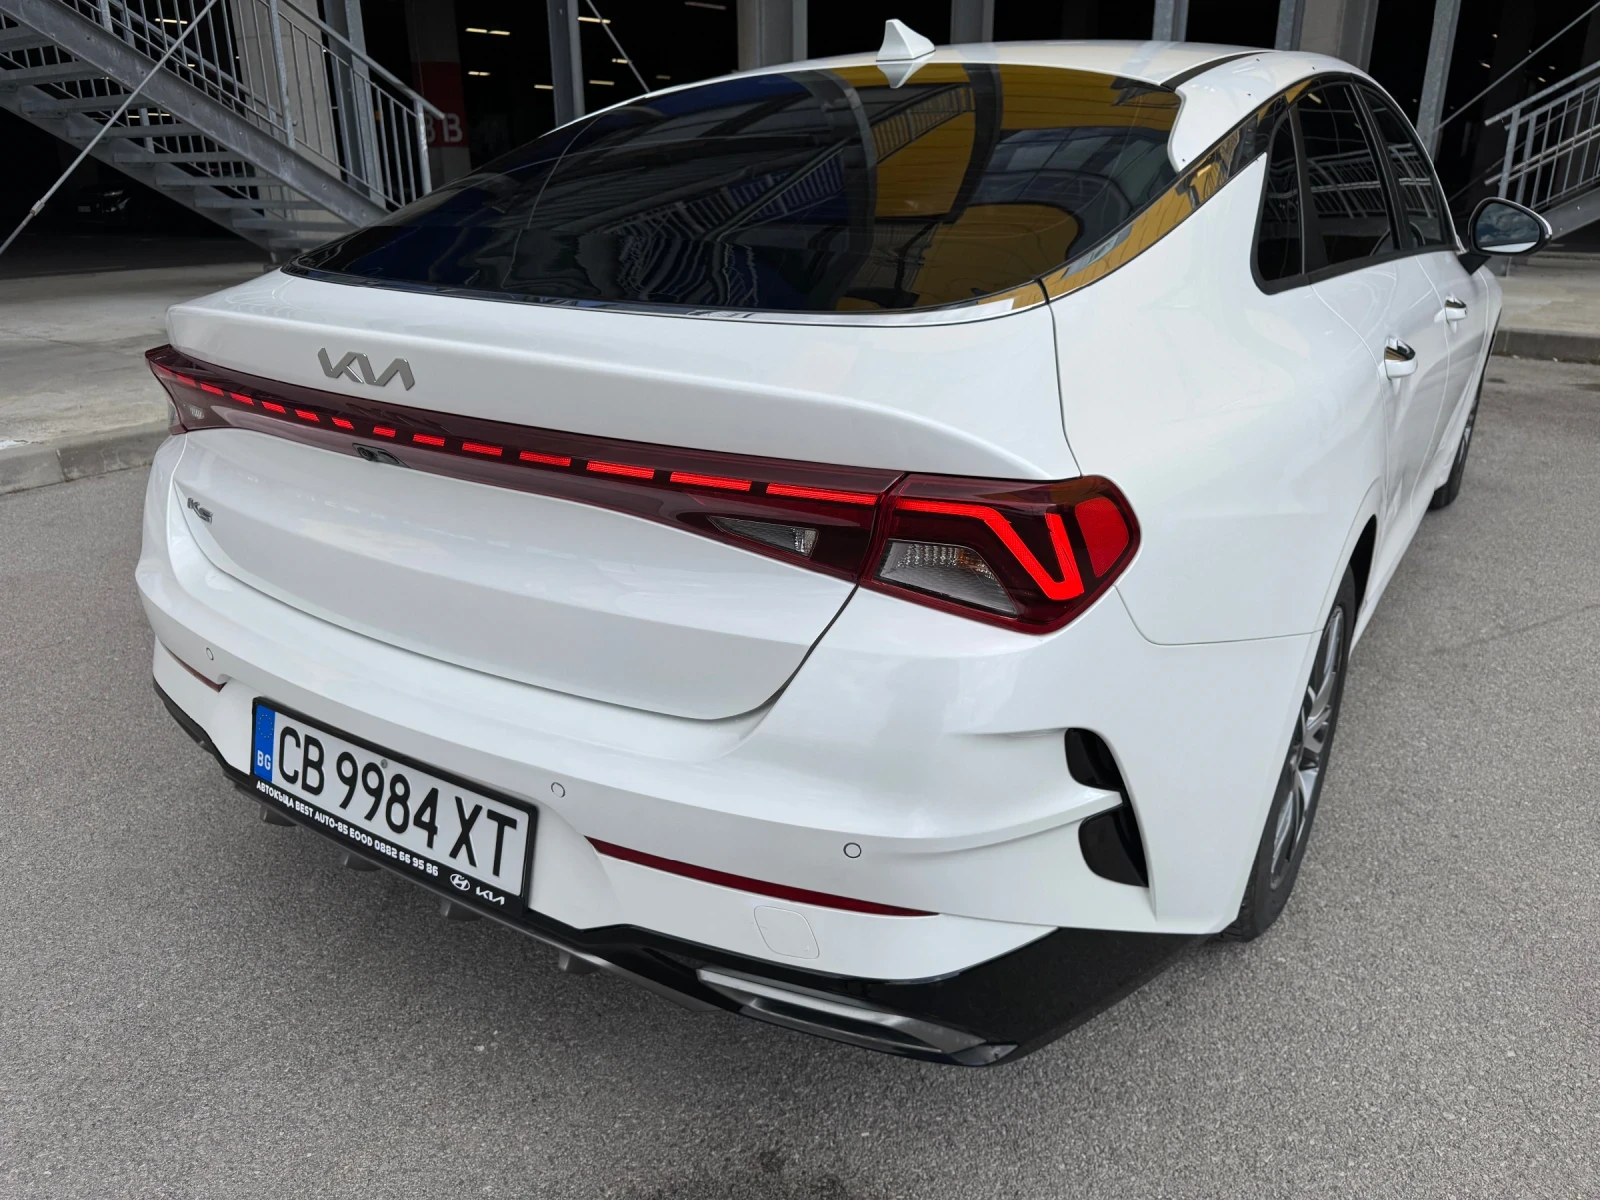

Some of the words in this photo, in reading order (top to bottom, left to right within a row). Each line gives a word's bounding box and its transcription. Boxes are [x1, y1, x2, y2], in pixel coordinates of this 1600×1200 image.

[317, 347, 415, 391] KIA
[187, 497, 213, 524] K5
[256, 750, 272, 771] BG
[278, 726, 325, 796] CB
[336, 751, 440, 850] 9984
[449, 795, 518, 878] XT
[295, 801, 314, 818] BEST
[314, 811, 349, 836] AUTO-85
[374, 839, 398, 859] 0882
[399, 850, 412, 864] 66
[412, 857, 425, 870] 95
[426, 864, 439, 877] 86
[475, 886, 505, 906] KIA
